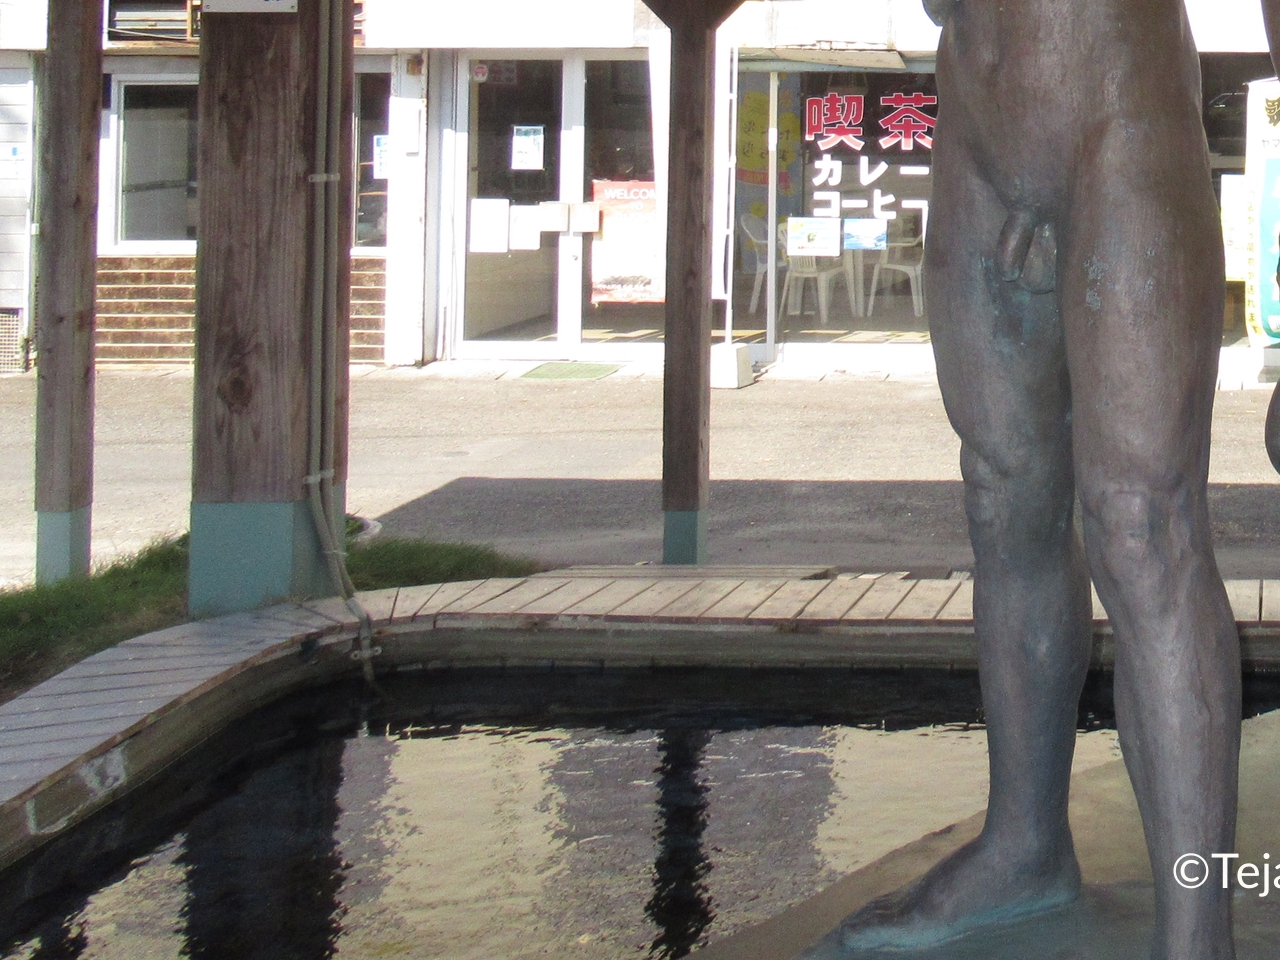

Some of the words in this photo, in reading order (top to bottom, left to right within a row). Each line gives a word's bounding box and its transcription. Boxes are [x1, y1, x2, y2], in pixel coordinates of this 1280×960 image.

[805, 92, 938, 151] 喫茶
[812, 153, 930, 187] カレー
